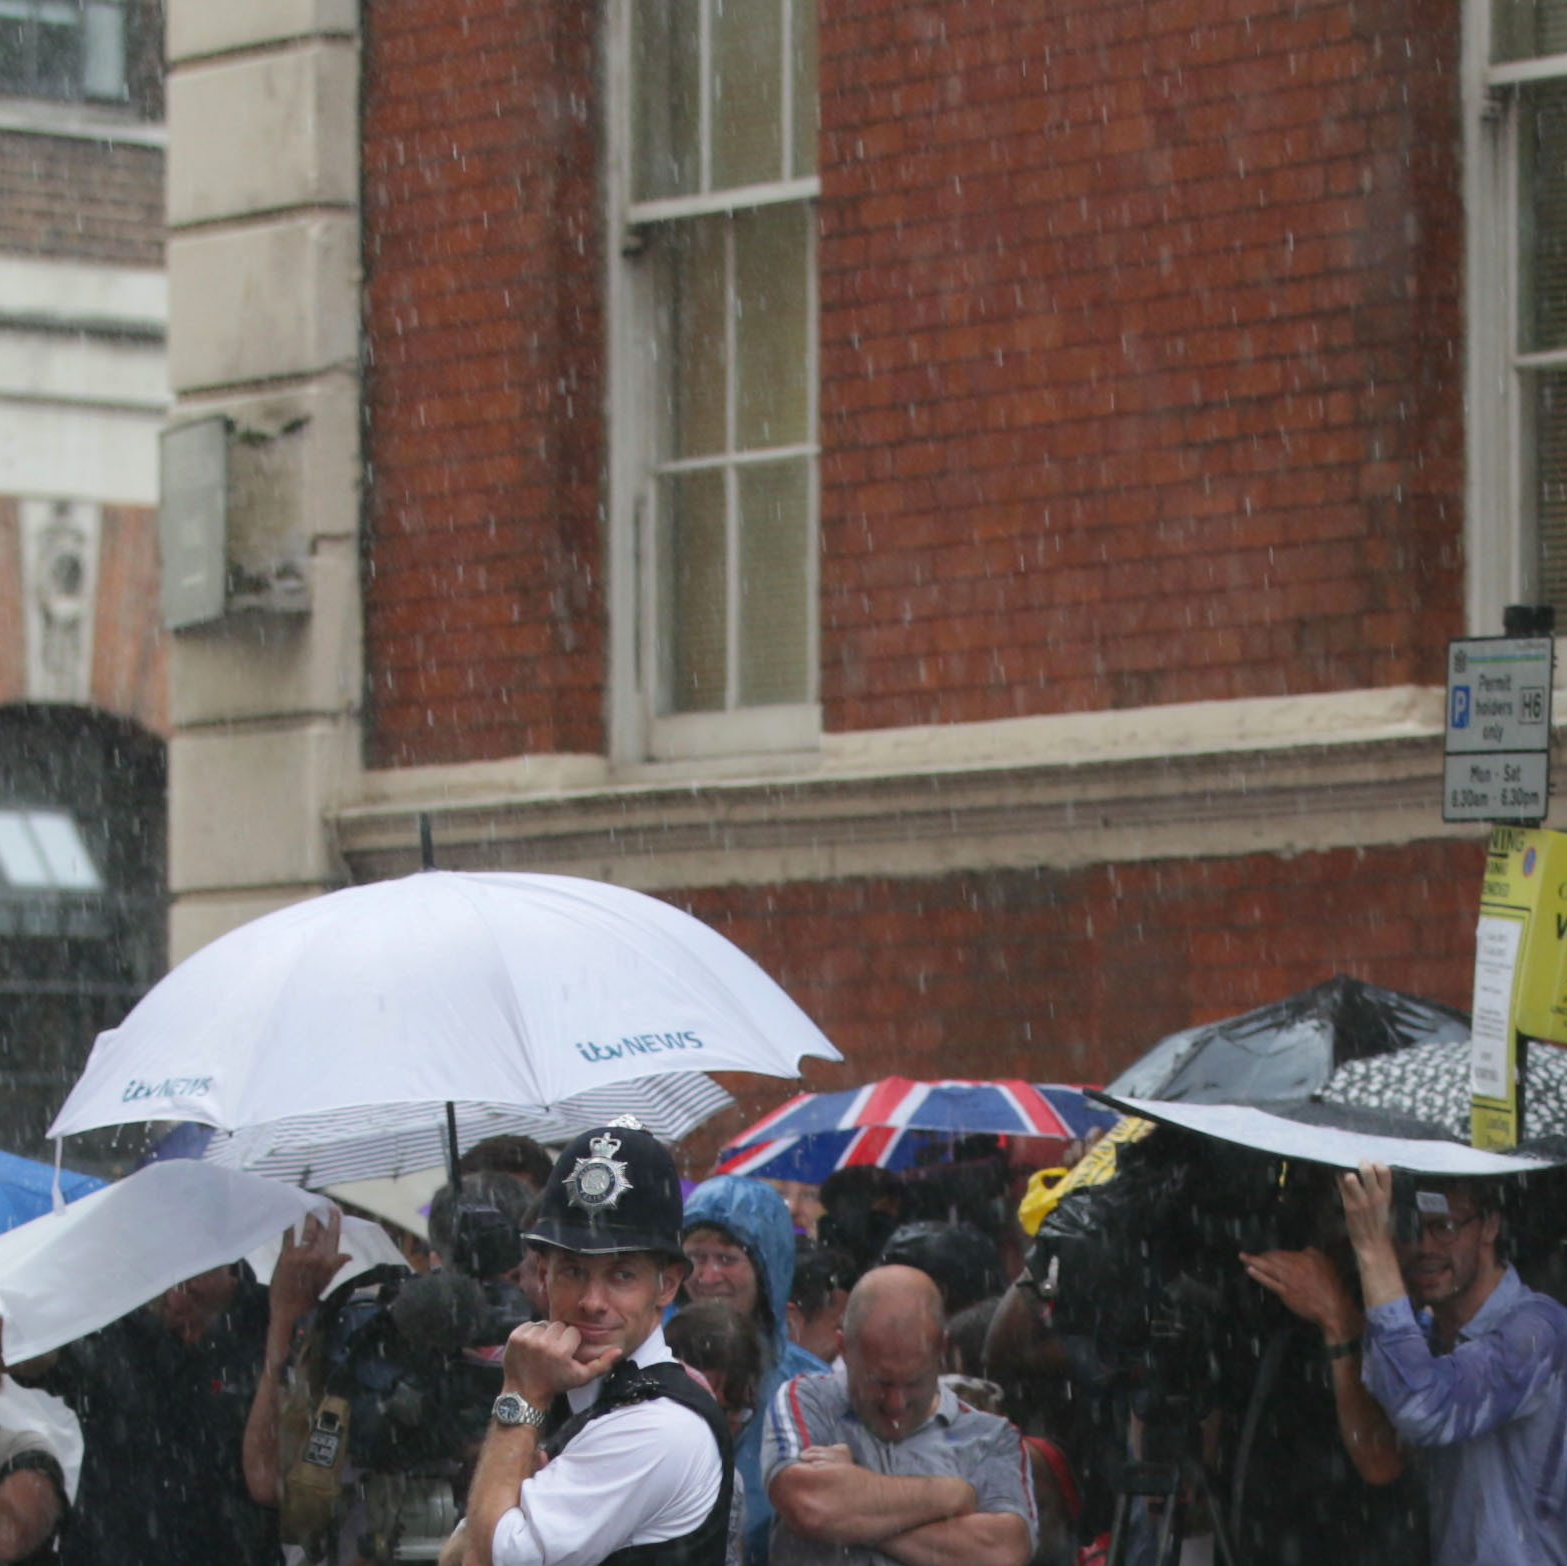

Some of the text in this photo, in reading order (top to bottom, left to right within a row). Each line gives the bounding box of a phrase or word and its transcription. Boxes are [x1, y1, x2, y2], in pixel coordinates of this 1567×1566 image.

[1478, 674, 1512, 692] Permit
[1453, 691, 1467, 726] P
[1475, 694, 1513, 717] holders
[1522, 693, 1543, 718] H6
[1482, 723, 1504, 743] only
[1470, 764, 1491, 783] Mon
[1503, 763, 1522, 783] Sat
